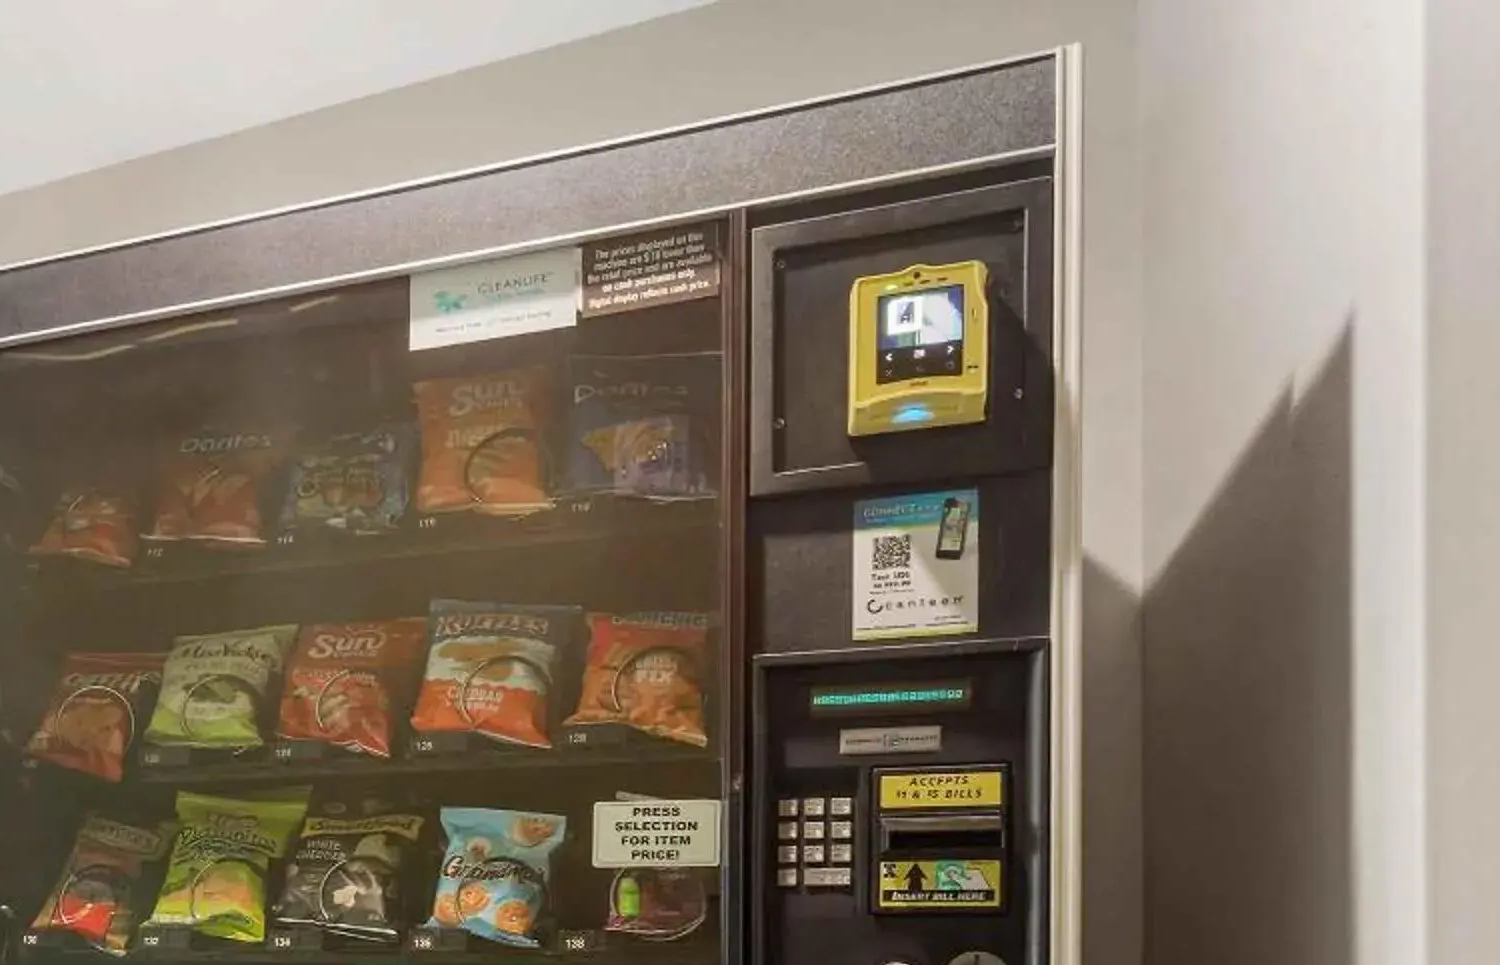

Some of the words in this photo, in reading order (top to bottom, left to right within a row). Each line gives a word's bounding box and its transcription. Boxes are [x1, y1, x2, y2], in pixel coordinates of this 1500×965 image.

[308, 634, 380, 658] Sun
[909, 775, 969, 787] ACCEPTS
[945, 789, 982, 800] BILLS
[632, 806, 681, 818] PRESS
[615, 820, 699, 832] SELECTION
[621, 835, 651, 846] FOR
[654, 834, 692, 846] ITEM
[631, 849, 680, 861] PRICE!
[891, 890, 930, 901] INSERT
[566, 939, 585, 949] 138
